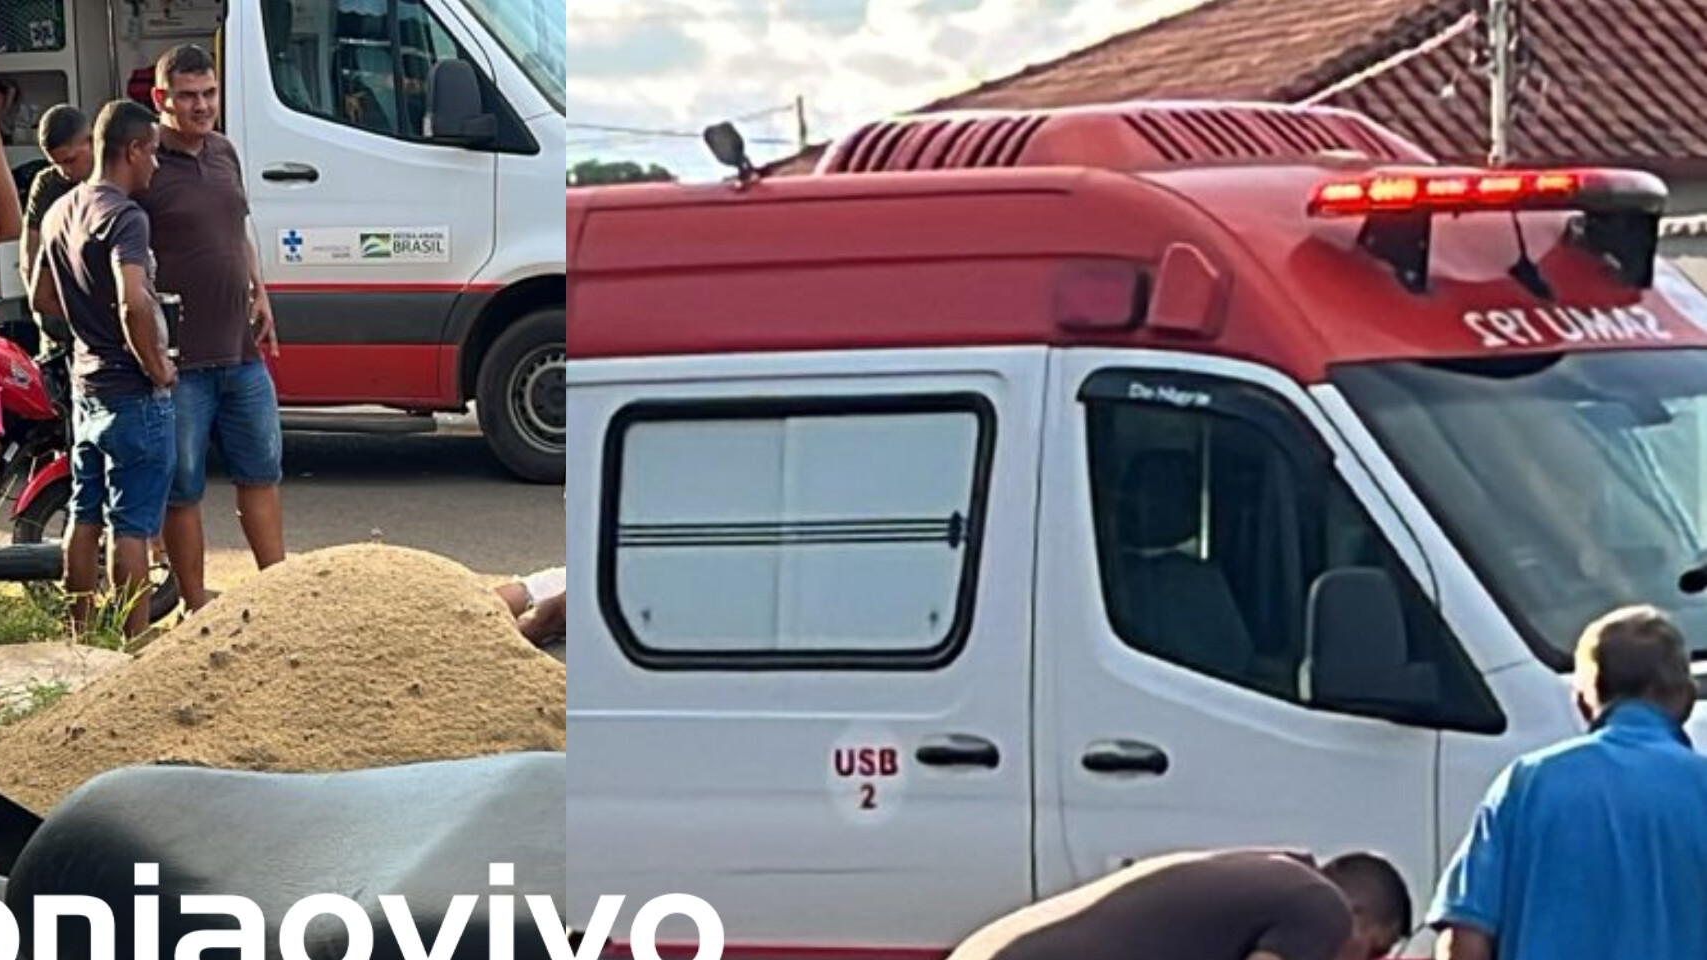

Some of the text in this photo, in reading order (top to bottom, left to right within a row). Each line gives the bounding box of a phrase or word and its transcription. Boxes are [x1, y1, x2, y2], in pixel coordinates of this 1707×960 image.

[393, 240, 444, 254] BRASIL
[835, 748, 899, 777] USB
[860, 783, 878, 810] 2
